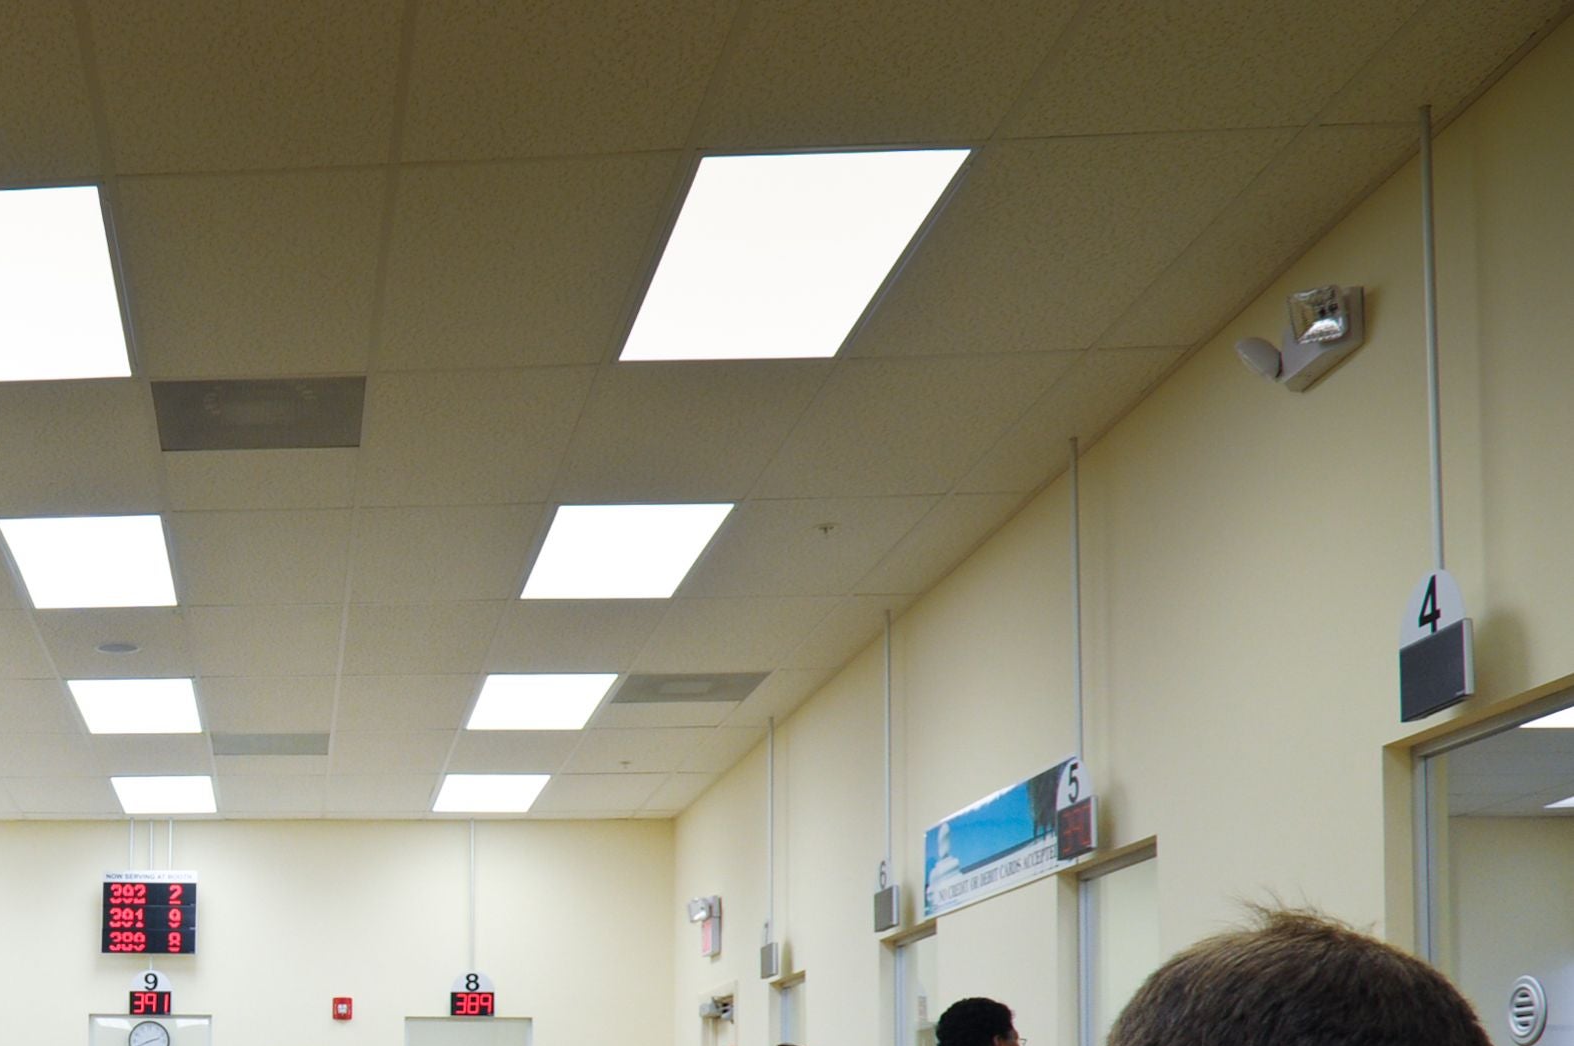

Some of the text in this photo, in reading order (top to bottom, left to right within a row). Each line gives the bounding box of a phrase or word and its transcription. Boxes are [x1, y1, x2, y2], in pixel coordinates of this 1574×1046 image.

[1418, 574, 1441, 634] 4
[1068, 762, 1079, 803] 5
[880, 860, 887, 889] 6
[169, 884, 183, 904] 2
[144, 973, 158, 991] 9
[466, 973, 479, 992] 8
[134, 993, 169, 1013] 391
[456, 993, 493, 1016] 389
